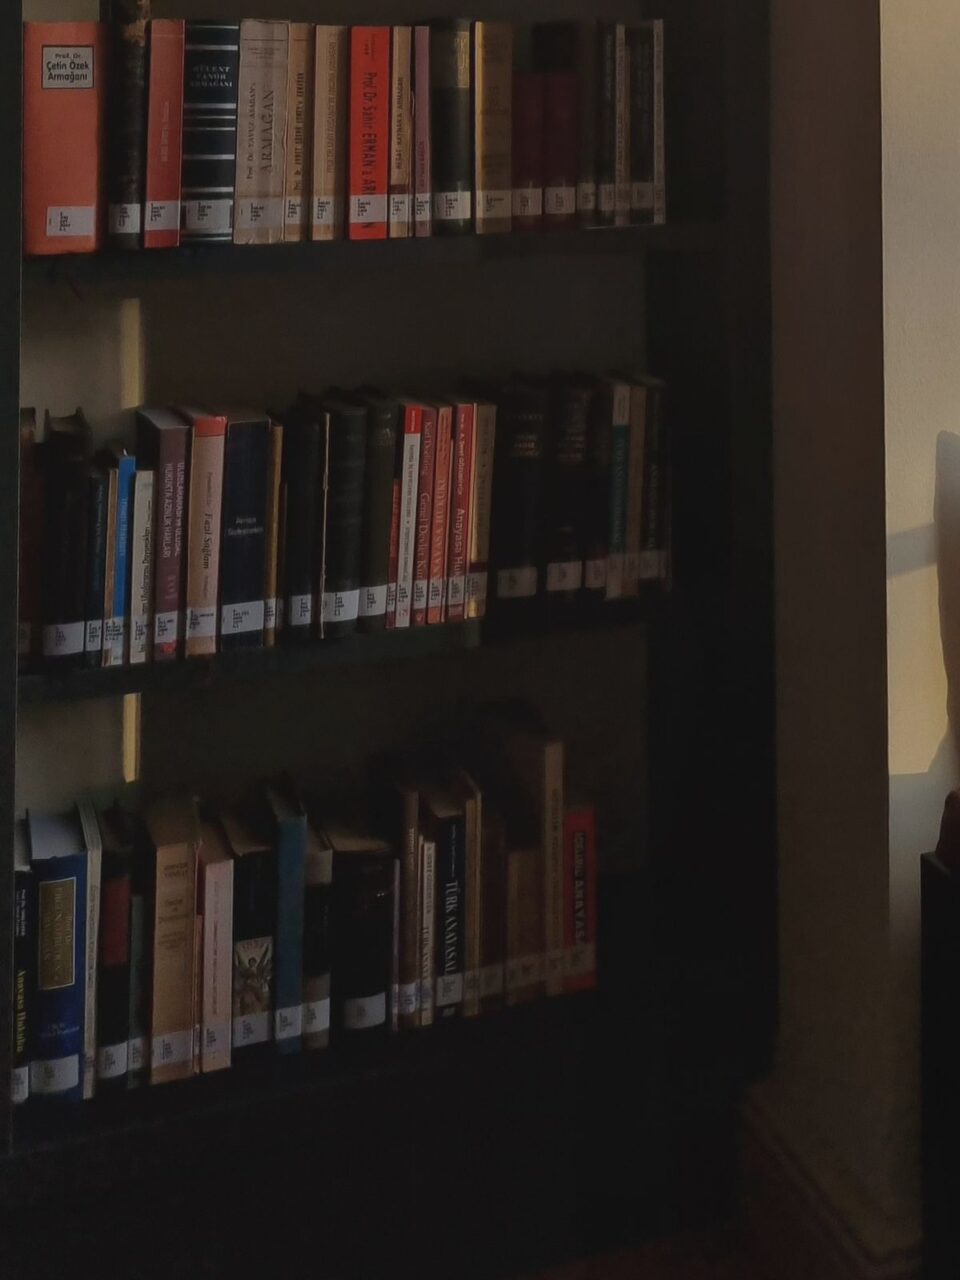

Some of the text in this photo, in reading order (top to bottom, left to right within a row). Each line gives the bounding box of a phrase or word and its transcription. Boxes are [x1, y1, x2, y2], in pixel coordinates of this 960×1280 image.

[46, 59, 89, 72] Çetin Özek
[47, 72, 88, 83] Armağanı
[364, 72, 377, 90] Prof.
[260, 89, 273, 174] ARMAĞAN
[363, 106, 377, 130] Sahir
[163, 463, 173, 499] HUKUKTA
[418, 492, 429, 522] Genel
[162, 526, 173, 558] HAKLARI
[416, 524, 427, 557] Devlet
[453, 508, 465, 553] Anayasa
[201, 537, 213, 570] Sağlam
[445, 880, 460, 914] TÜRK
[16, 968, 27, 1053] Anayasa Hukuku
